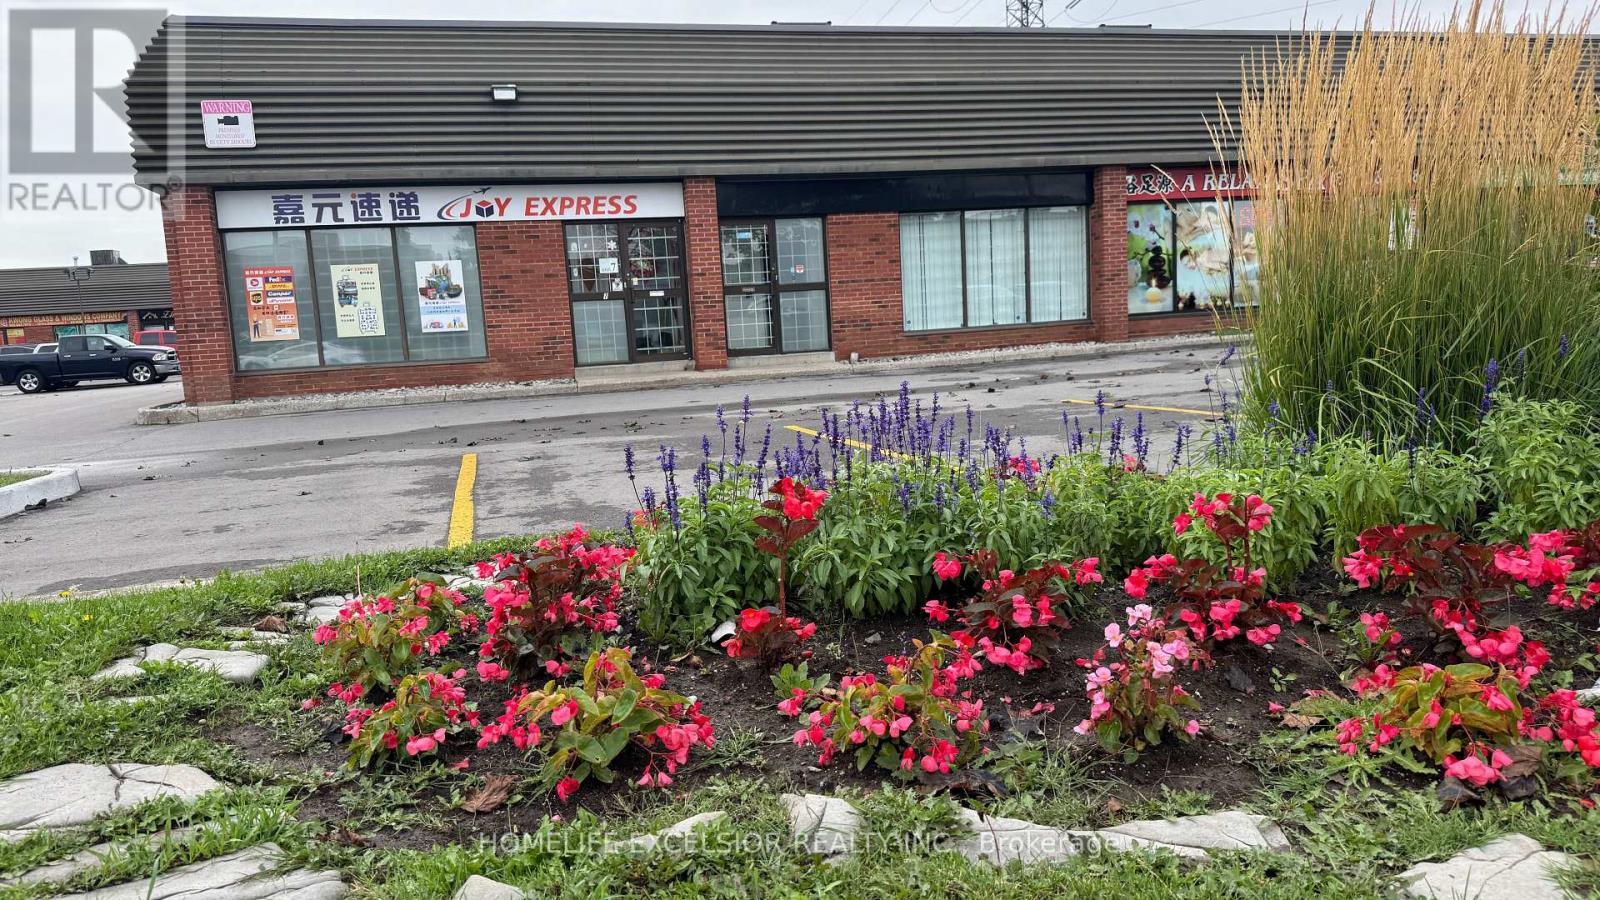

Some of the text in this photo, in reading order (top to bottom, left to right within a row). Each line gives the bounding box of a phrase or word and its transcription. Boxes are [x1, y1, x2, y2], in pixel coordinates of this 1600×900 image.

[203, 102, 250, 113] WARNING
[1181, 175, 1196, 192] A
[272, 191, 421, 225] 嘉元速递
[524, 195, 638, 217] EXPRESS
[33, 315, 54, 323] GLASS
[91, 312, 121, 320] COMPANY
